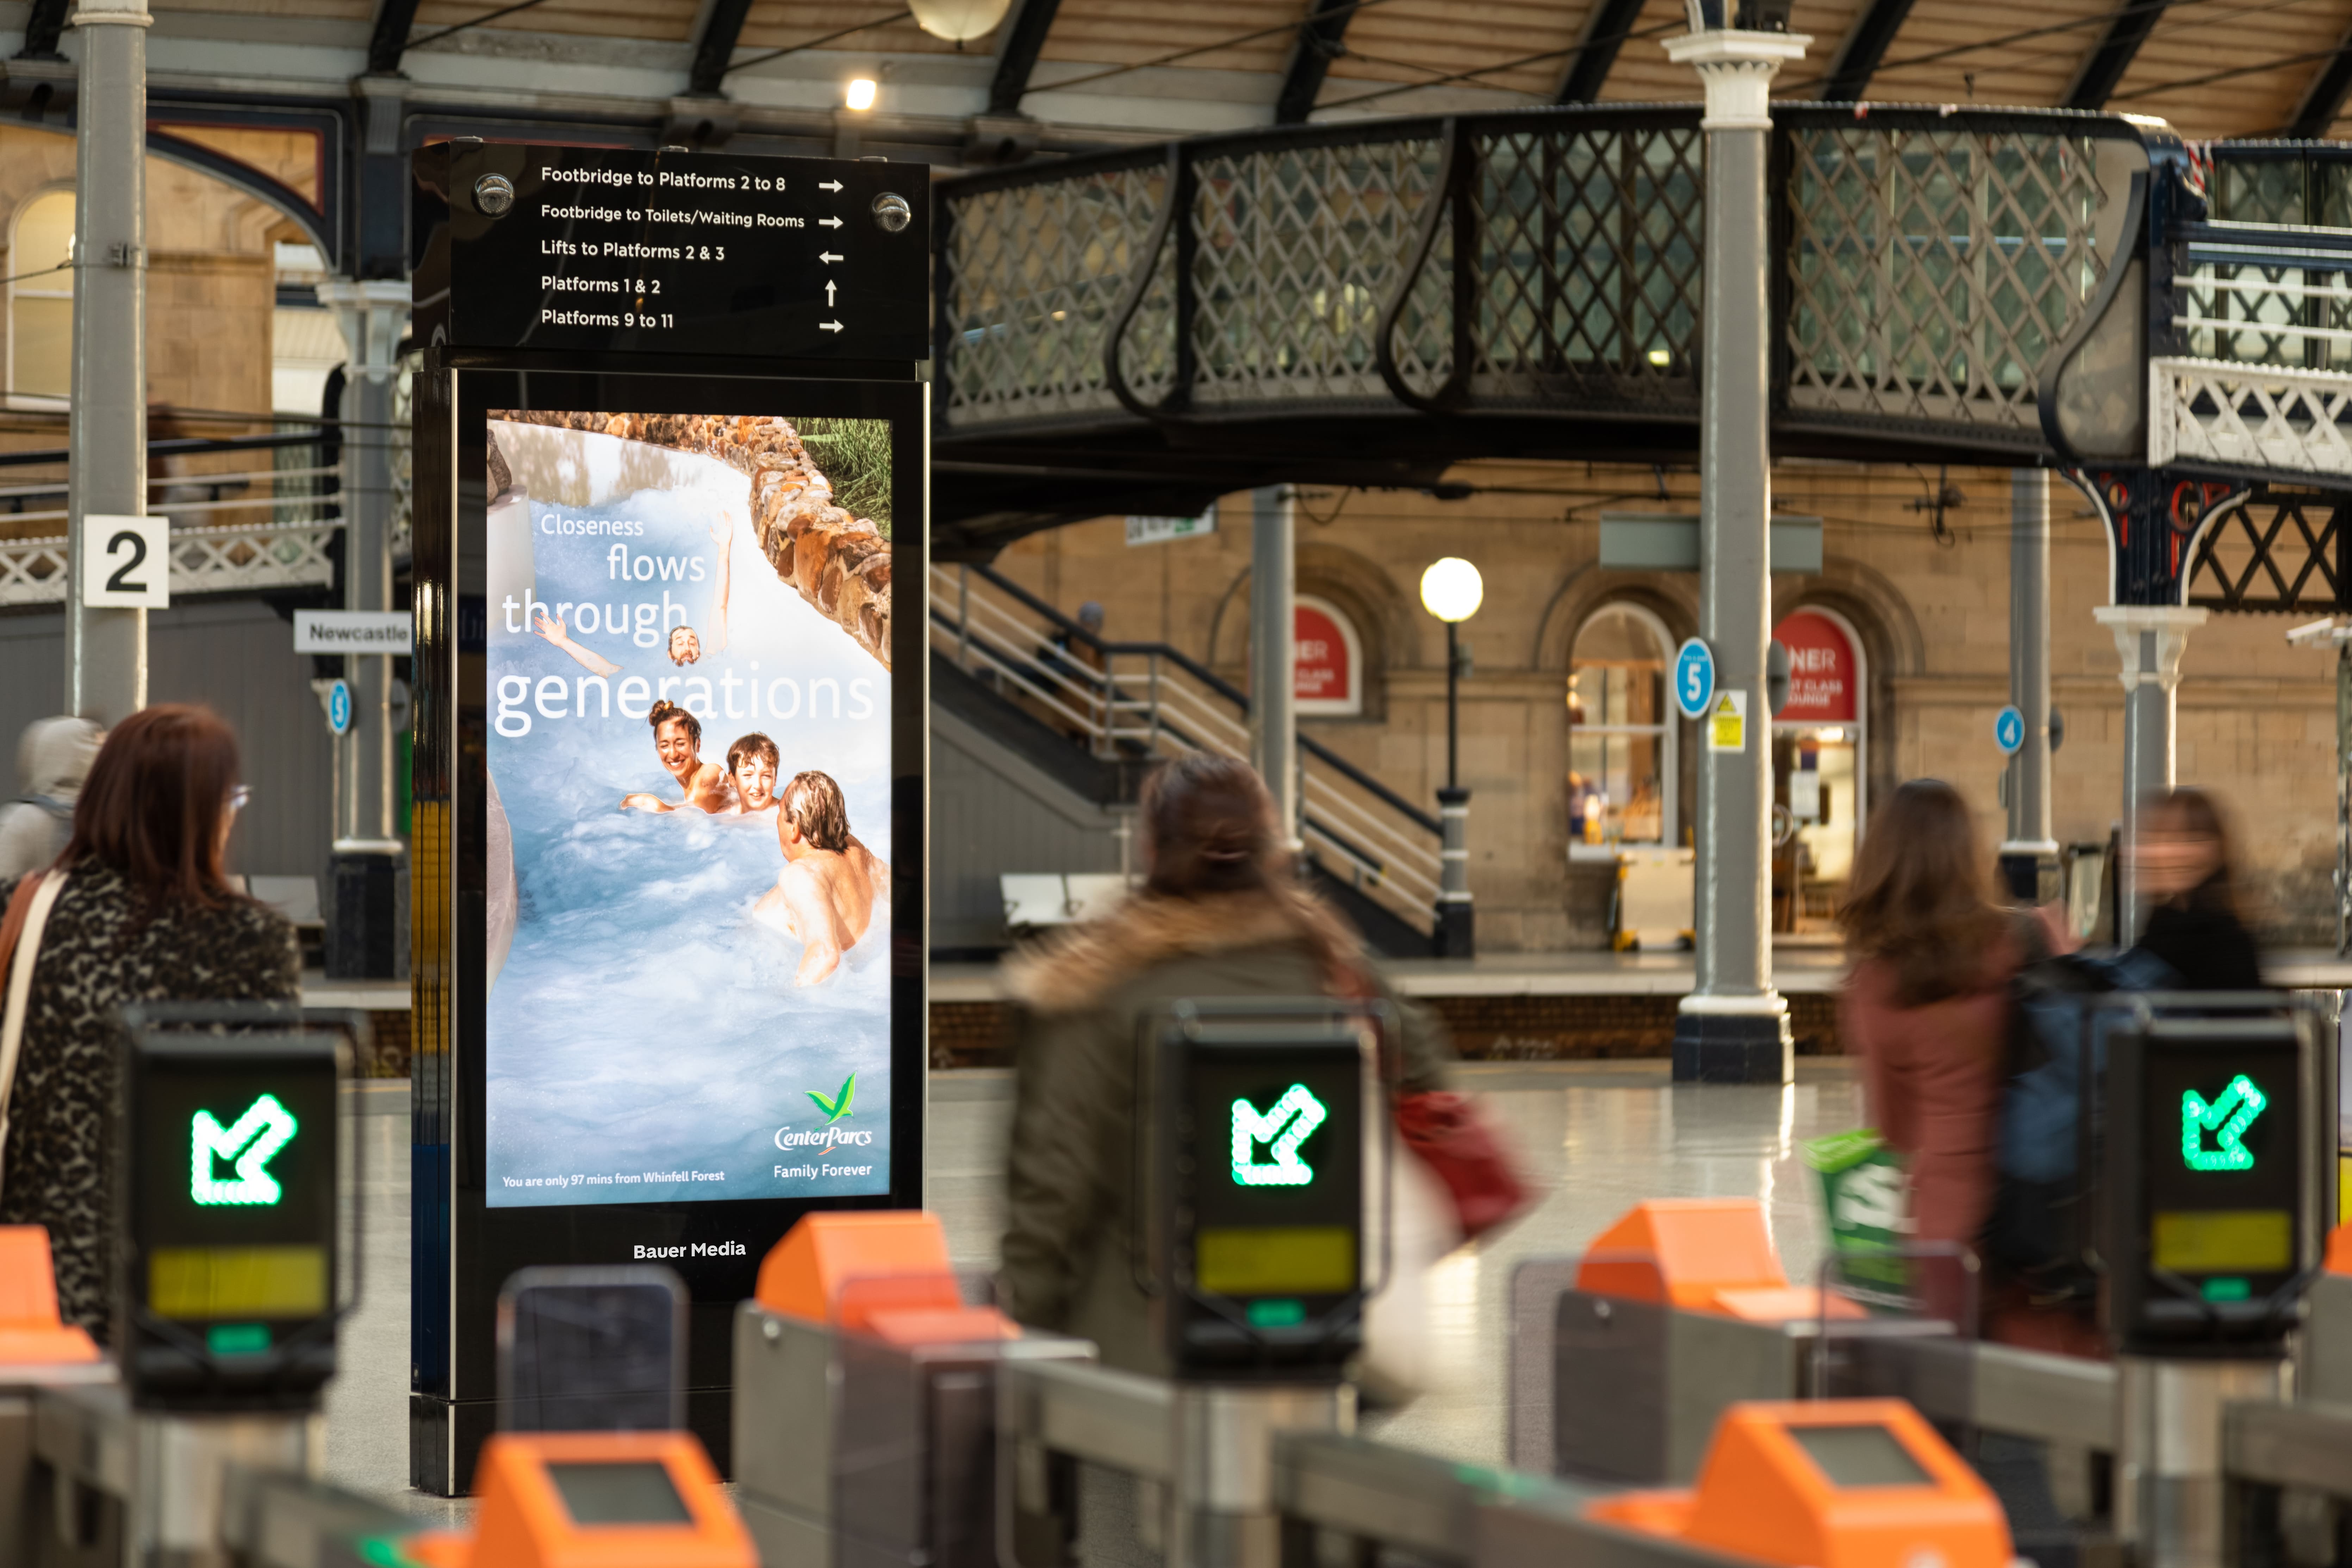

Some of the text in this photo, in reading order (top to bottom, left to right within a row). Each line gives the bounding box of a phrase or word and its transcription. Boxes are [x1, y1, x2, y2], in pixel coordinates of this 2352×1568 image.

[541, 166, 786, 192] Footbridge to Platforms 2 to 8
[541, 204, 805, 228] Footbridge to Toilets/Waiting Rooms
[541, 239, 725, 261] Lifts to Platforms 2 & 3
[541, 275, 661, 294] Platforms 1 & 2
[541, 309, 673, 329] Platforms 9 to 11
[541, 513, 644, 536] Closeness
[105, 530, 148, 592] 2
[607, 543, 705, 581] flows
[502, 588, 687, 648] through
[310, 623, 408, 641] Newcastle
[1788, 646, 1836, 672] NER
[1687, 662, 1701, 702] 5
[335, 697, 344, 723] 5
[494, 660, 874, 738] generations
[502, 1170, 725, 1189] You are only 97 mins from Whinfell Forest
[773, 1163, 873, 1181] Family Forever
[633, 1240, 747, 1259] Bauer Media
